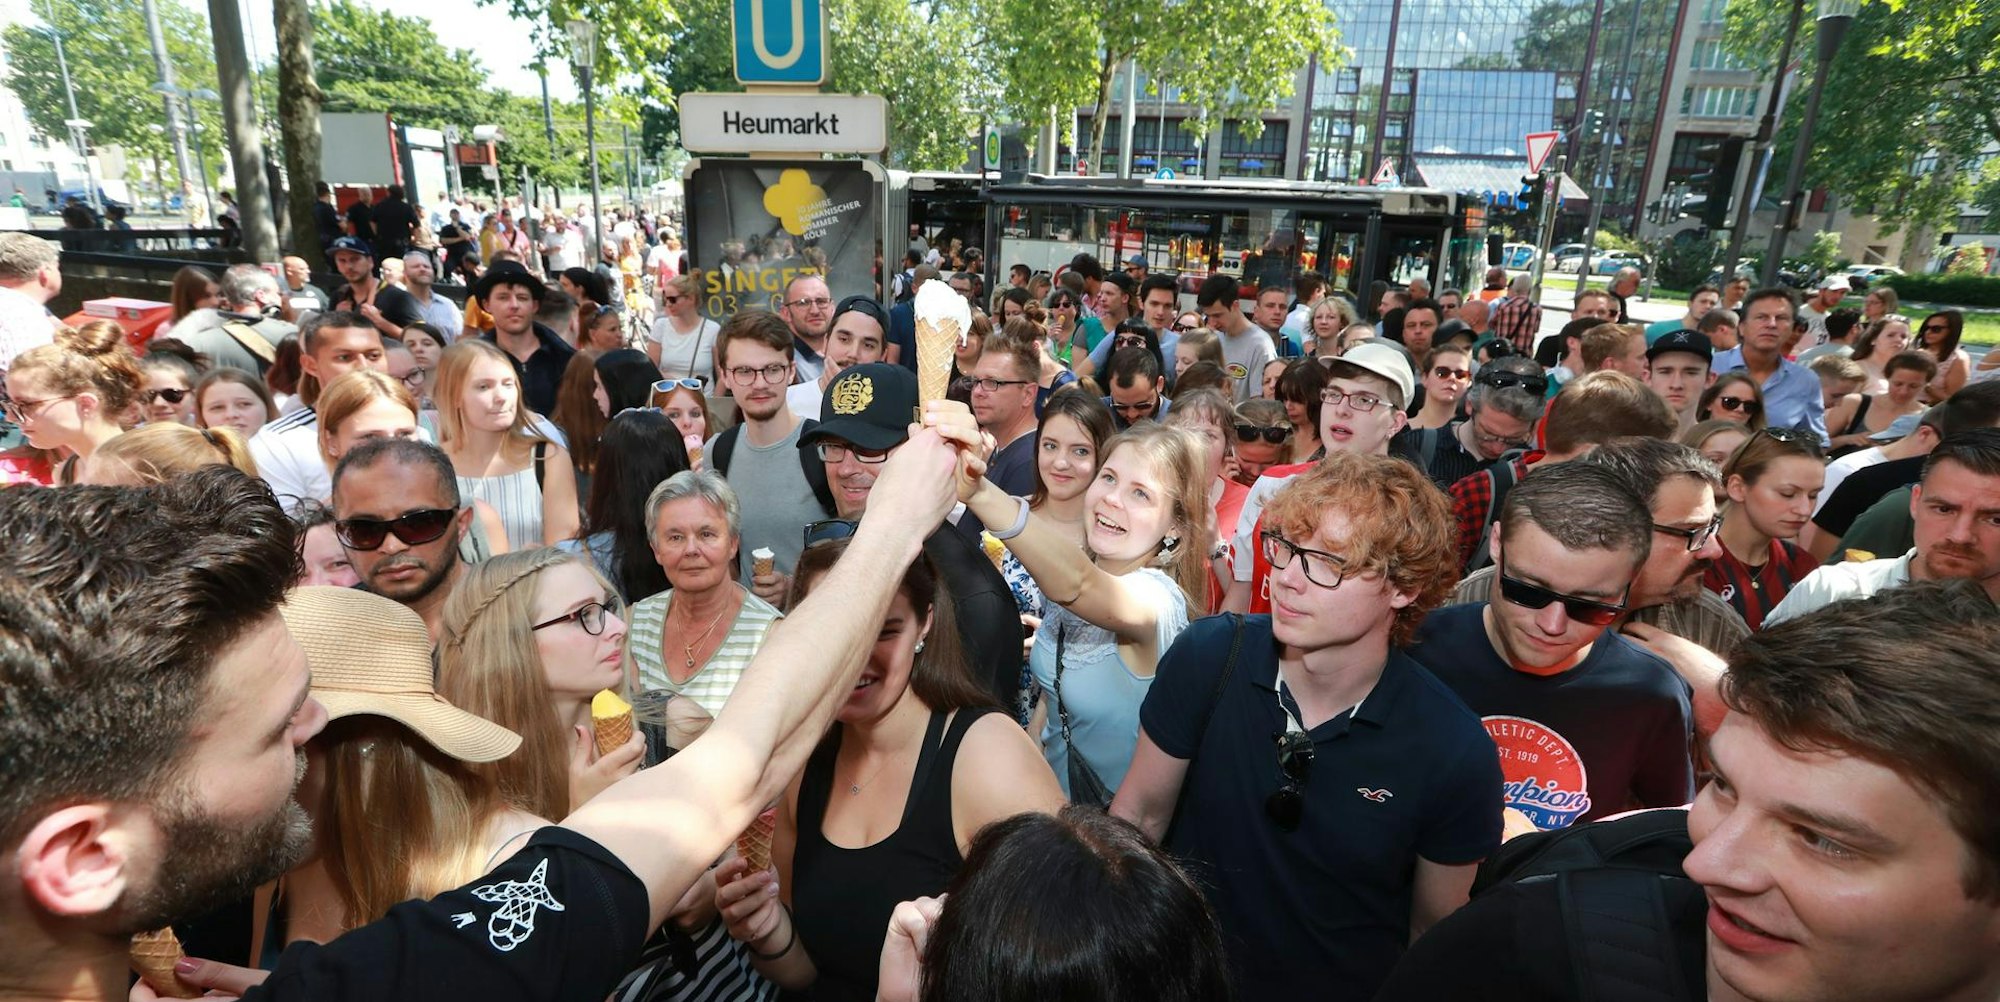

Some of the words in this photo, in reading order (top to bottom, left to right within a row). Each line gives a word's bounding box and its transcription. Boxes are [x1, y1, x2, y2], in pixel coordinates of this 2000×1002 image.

[751, 0, 804, 69] U
[723, 111, 839, 135] Heumarkt
[799, 200, 862, 223] ROMANISCHER
[807, 198, 833, 213] JAHRE
[803, 228, 827, 241] KÖLN
[708, 294, 738, 318] 03
[771, 293, 784, 316] 0
[1485, 723, 1536, 740] LETIC
[1537, 735, 1569, 770] DEPT.
[1498, 746, 1512, 759] ST.
[1517, 750, 1539, 764] 1919
[1504, 776, 1587, 808] mpion
